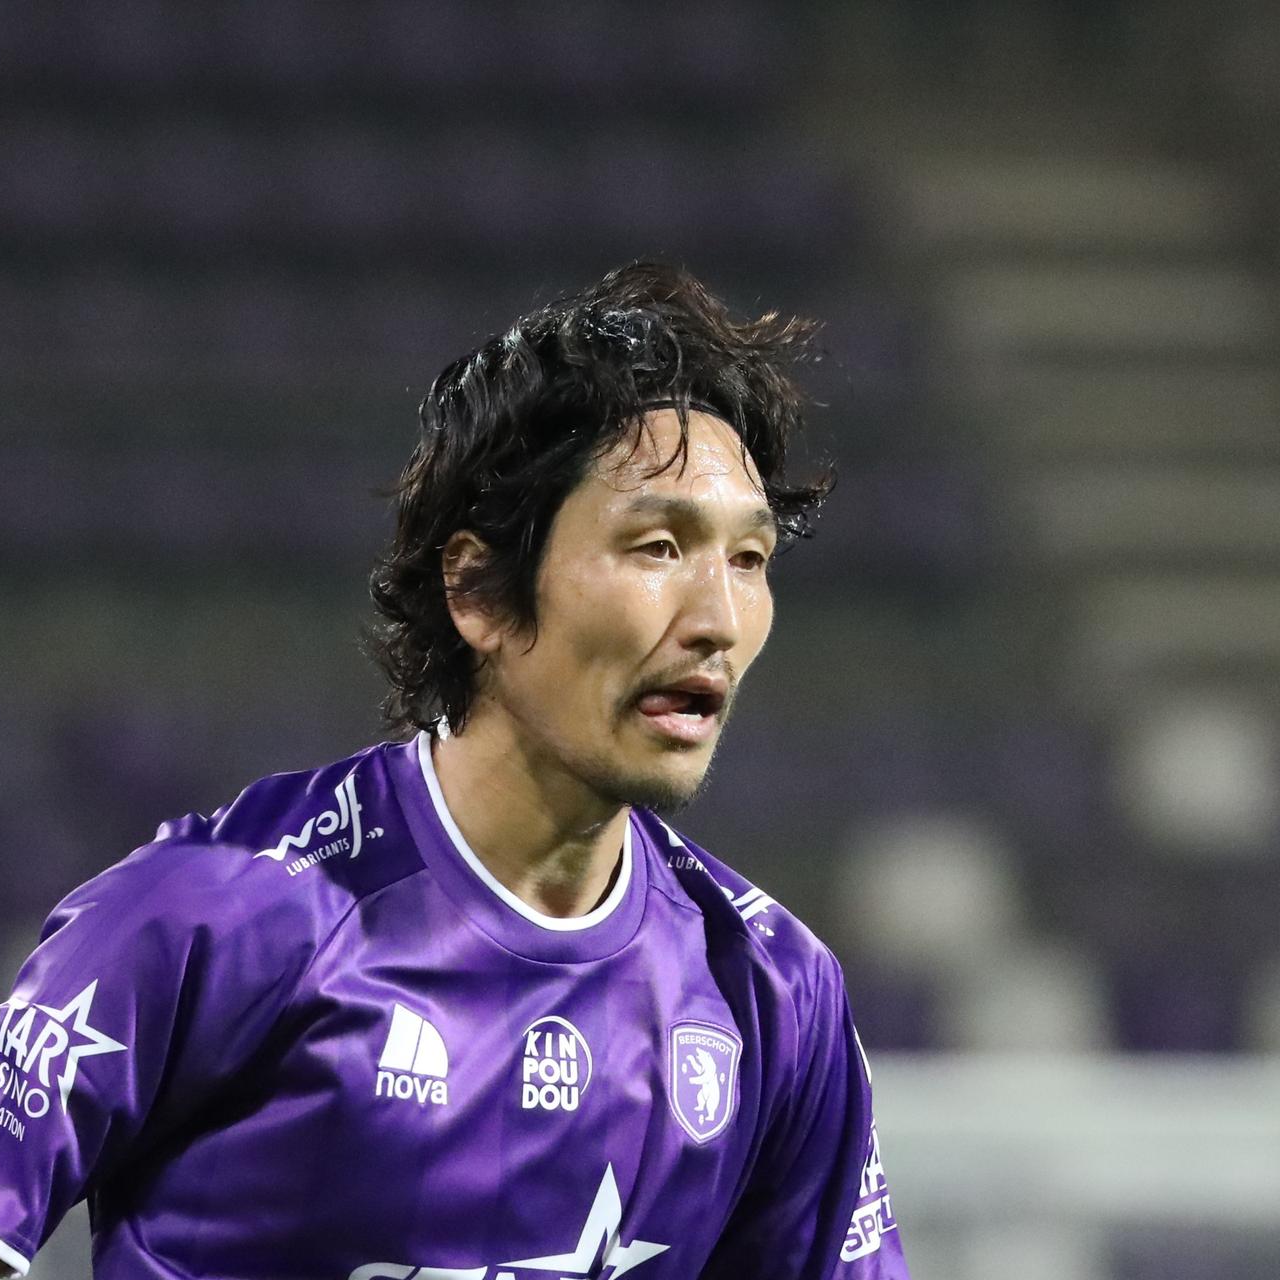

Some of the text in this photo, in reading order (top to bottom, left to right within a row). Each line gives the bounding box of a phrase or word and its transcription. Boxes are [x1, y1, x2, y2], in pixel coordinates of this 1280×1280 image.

[286, 837, 350, 876] LUBRICANTS
[524, 1031, 577, 1058] KIN
[678, 1034, 732, 1056] BEERSCHOT
[523, 1057, 579, 1084] POU
[375, 1070, 448, 1105] nova
[522, 1083, 579, 1111] DOU
